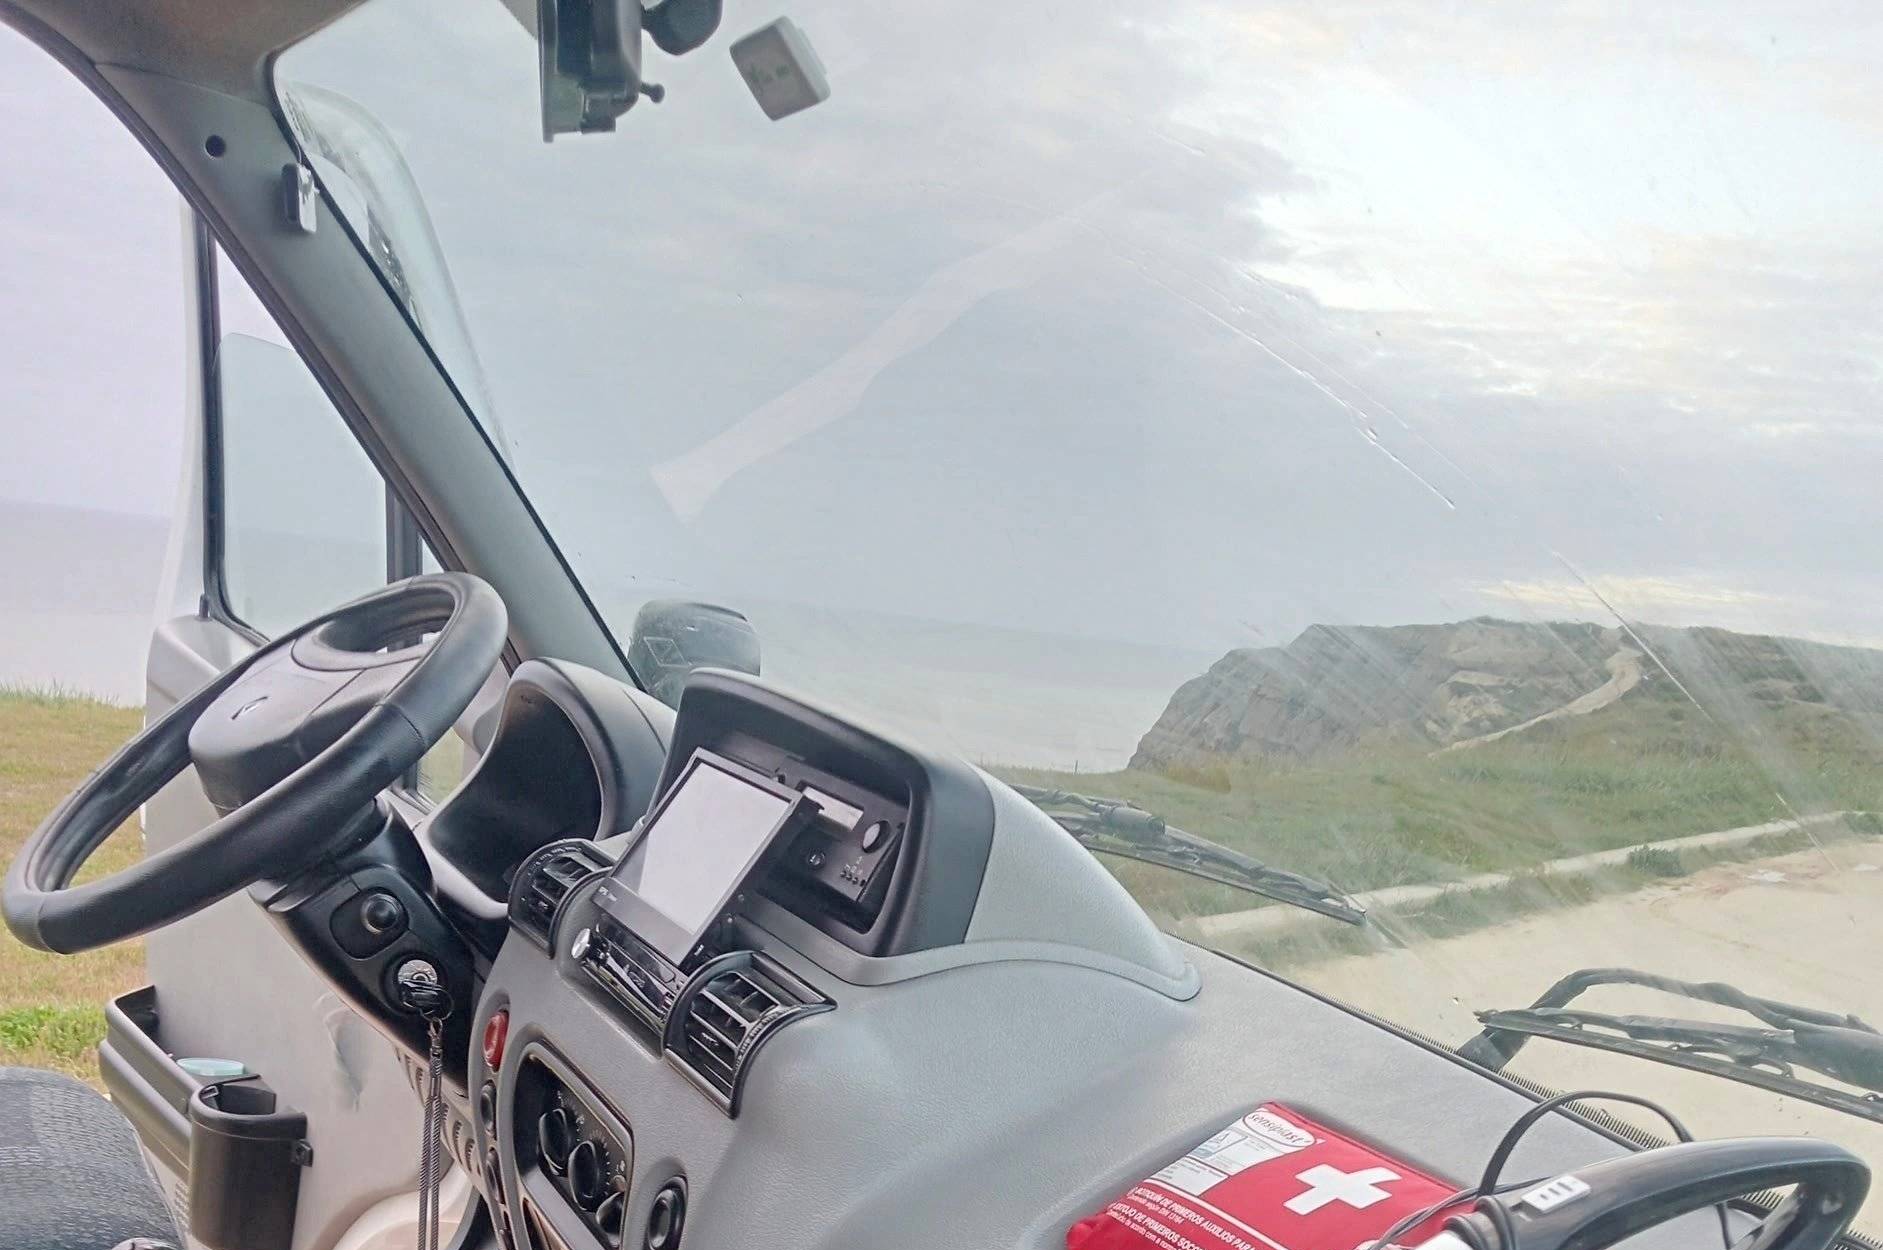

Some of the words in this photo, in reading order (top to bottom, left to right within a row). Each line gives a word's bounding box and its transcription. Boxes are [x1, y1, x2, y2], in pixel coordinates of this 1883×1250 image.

[1134, 1212, 1147, 1222] DE
[1142, 1216, 1181, 1243] PRIMEIROS
[1168, 1202, 1205, 1225] PRIMEROS
[1200, 1219, 1235, 1243] AUXILIOS
